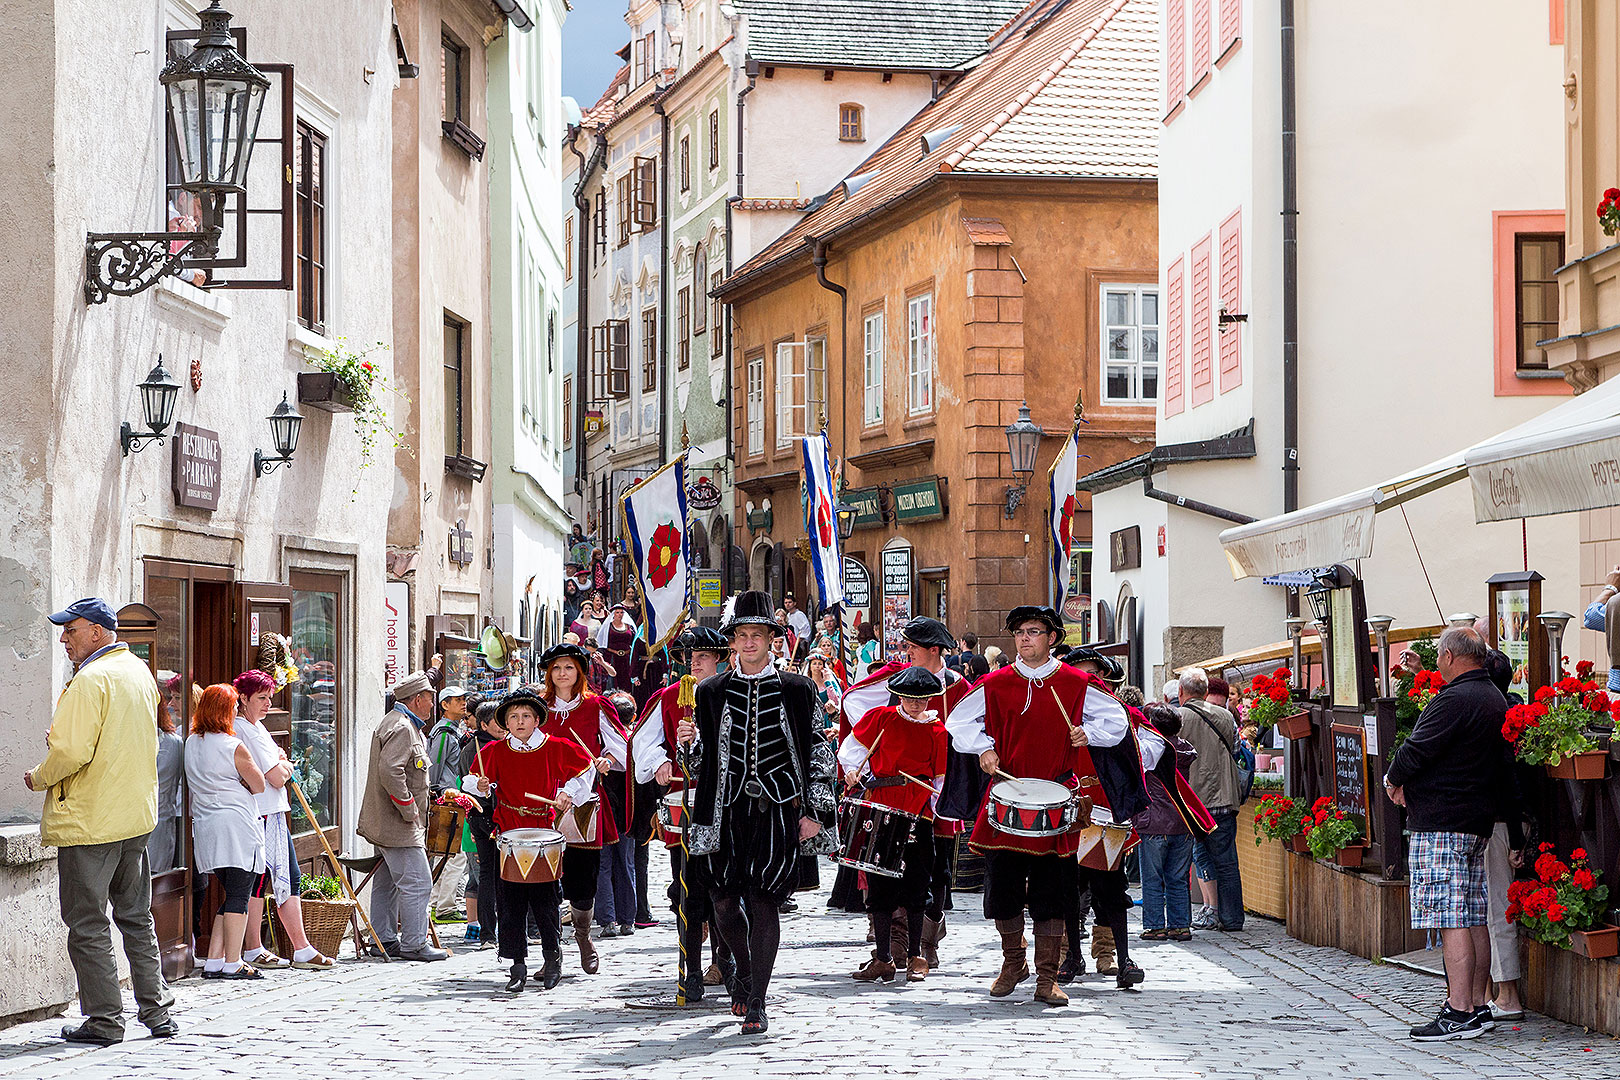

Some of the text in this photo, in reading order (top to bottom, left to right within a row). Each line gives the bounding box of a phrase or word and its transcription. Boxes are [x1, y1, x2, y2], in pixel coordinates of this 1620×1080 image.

[182, 431, 218, 462] RESTAURACE
[897, 490, 936, 511] MUZEUM OBCHODU
[885, 553, 908, 566] MUZEUM
[885, 565, 908, 575] OBCHODU
[846, 582, 868, 593] MUZEUM
[886, 583, 908, 592] KRUMLOV
[852, 593, 868, 604] SHOP
[386, 619, 400, 685] hotel mlýn
